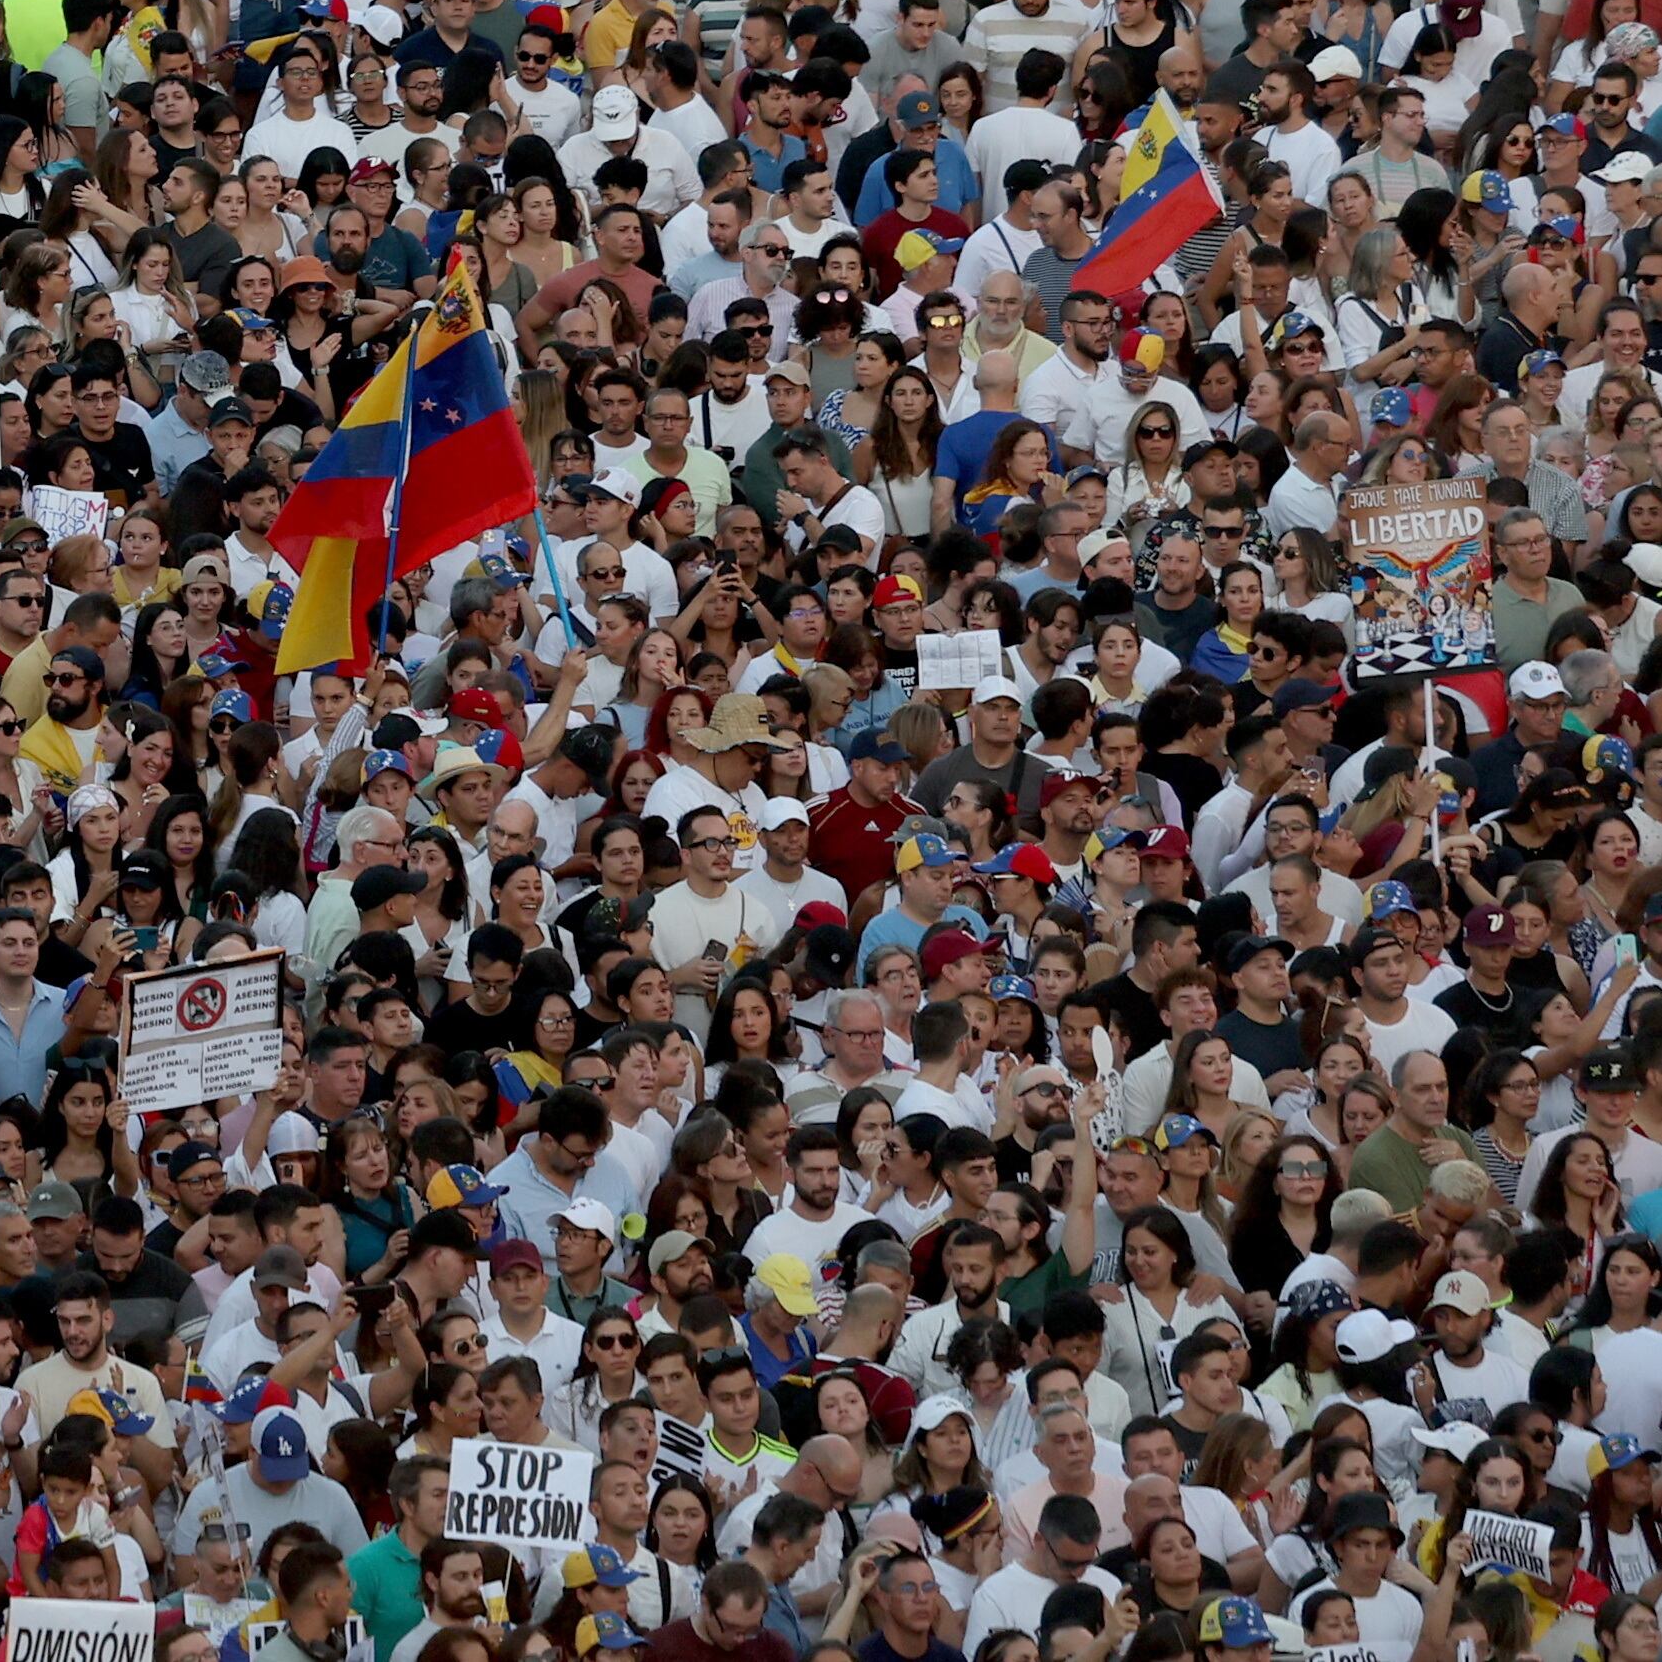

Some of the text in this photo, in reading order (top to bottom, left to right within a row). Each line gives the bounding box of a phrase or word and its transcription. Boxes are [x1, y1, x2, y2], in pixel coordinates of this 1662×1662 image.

[1349, 479, 1483, 510] JAQUE MATE MUNDIAL
[1350, 506, 1485, 547] LIBERTAD
[235, 973, 277, 988] ASESINO
[234, 987, 276, 1002] ASESINO
[233, 1000, 275, 1015] ASESINO
[207, 1040, 243, 1053] LIBERTAD
[259, 1033, 280, 1042] ESOS
[263, 1043, 280, 1053] QUE
[147, 1049, 177, 1063] ESTO ES
[250, 1054, 280, 1065] SIENDO
[125, 1066, 150, 1078] HASTA
[151, 1064, 160, 1072] EL
[125, 1067, 199, 1087] MADURO ES UN
[205, 1069, 255, 1085] TORTURADOS
[203, 1085, 223, 1095] ESTA
[476, 1445, 563, 1493] STOP
[1469, 1514, 1537, 1554] MADURO
